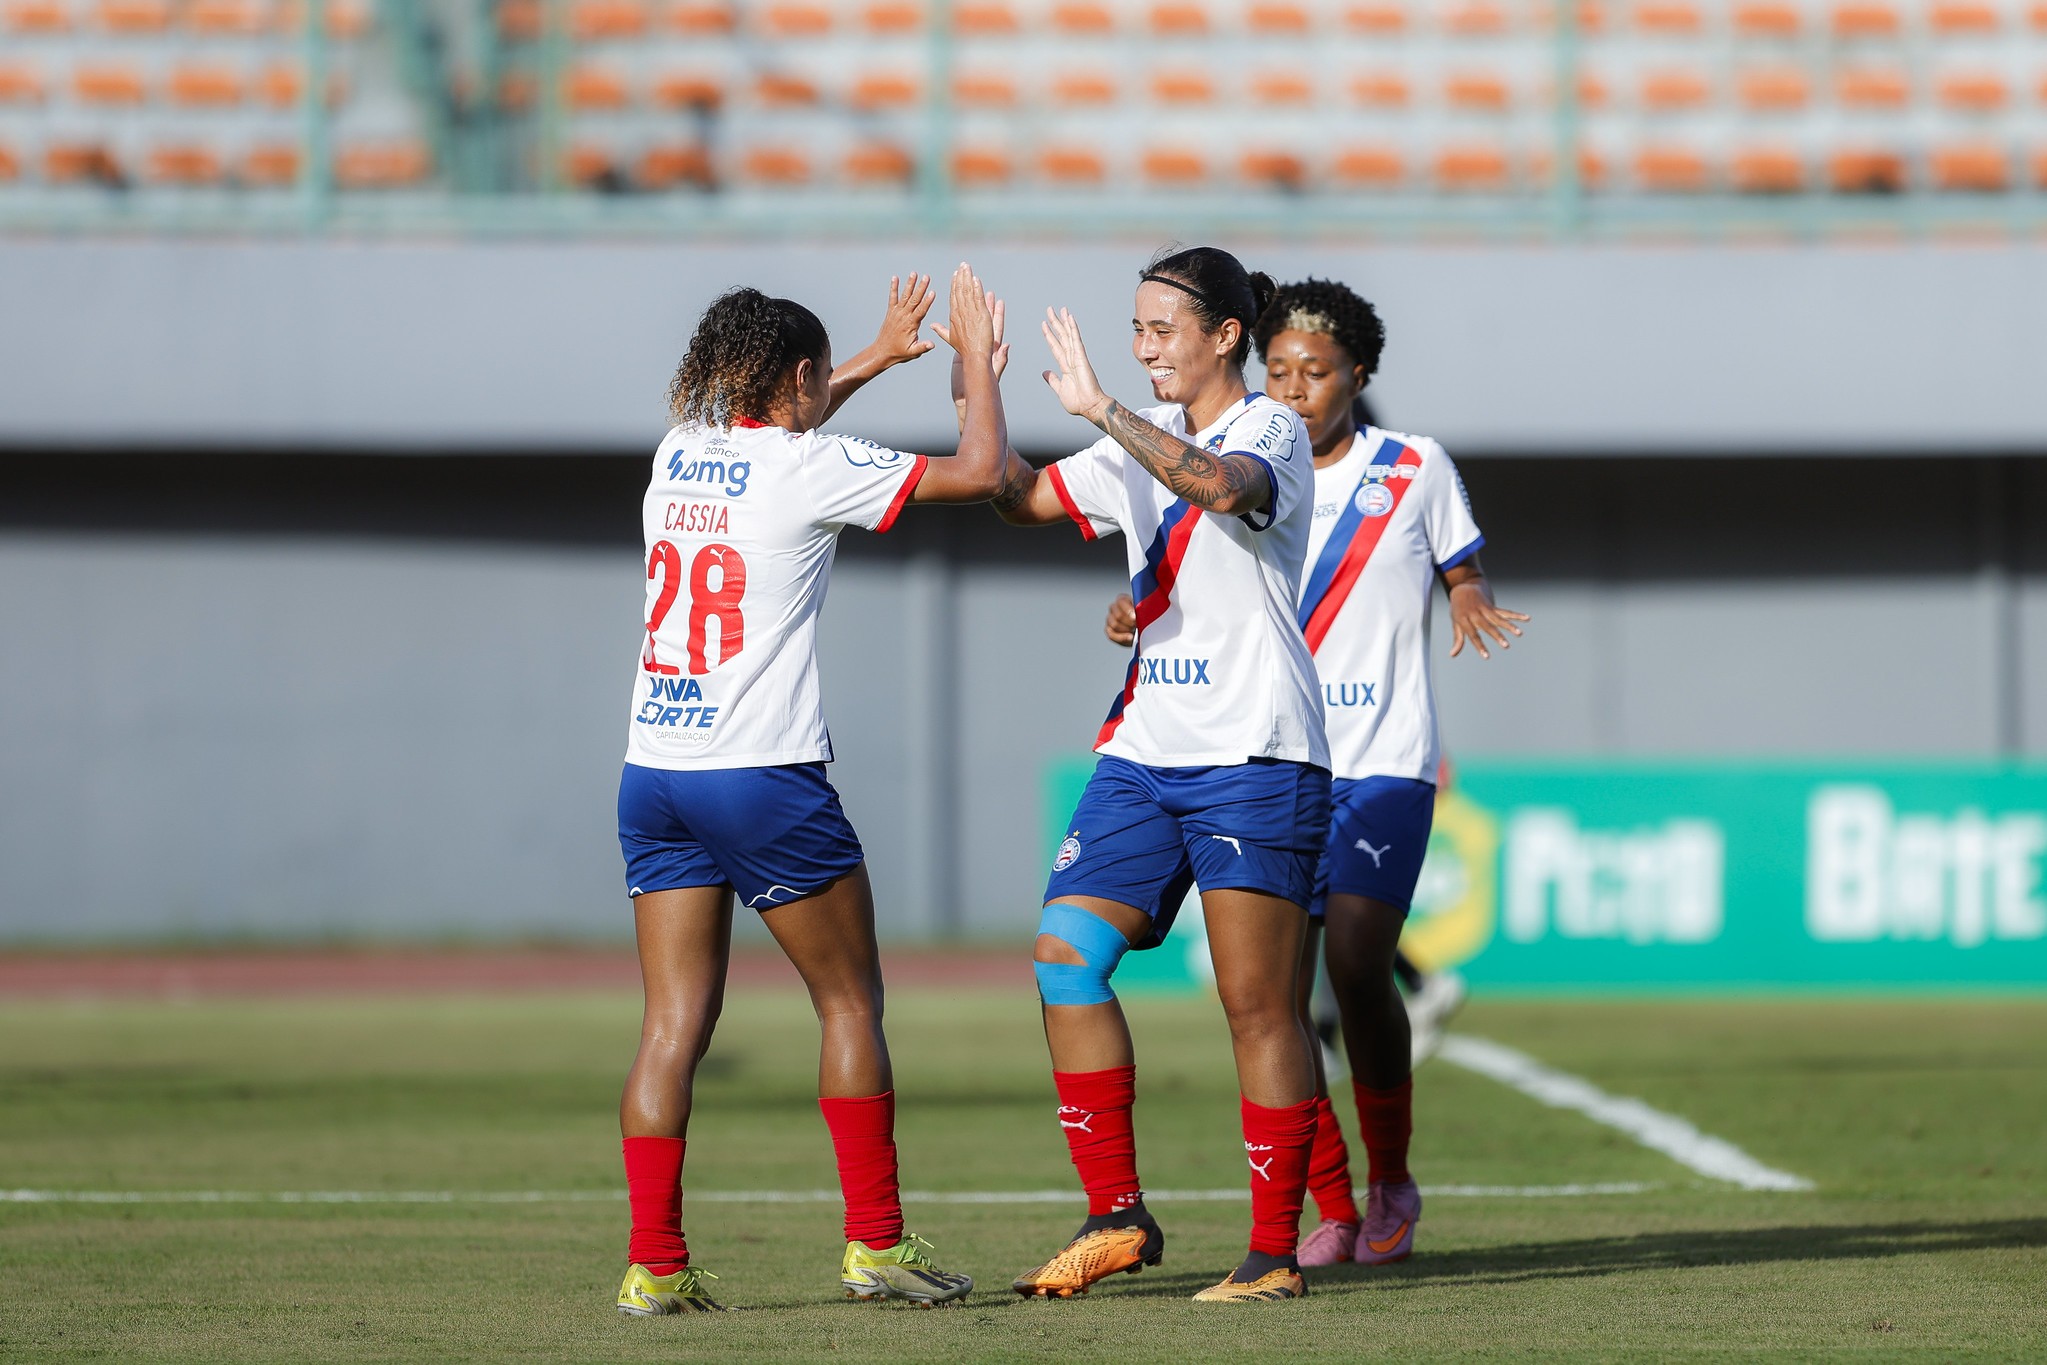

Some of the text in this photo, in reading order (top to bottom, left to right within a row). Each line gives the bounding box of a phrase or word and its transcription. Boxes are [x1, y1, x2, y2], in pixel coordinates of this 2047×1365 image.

[704, 446, 740, 458] banco
[677, 455, 752, 497] bmg
[665, 502, 728, 534] CASSIA
[643, 540, 746, 675] 28
[650, 677, 702, 701] VIVA
[1320, 683, 1375, 706] LUX
